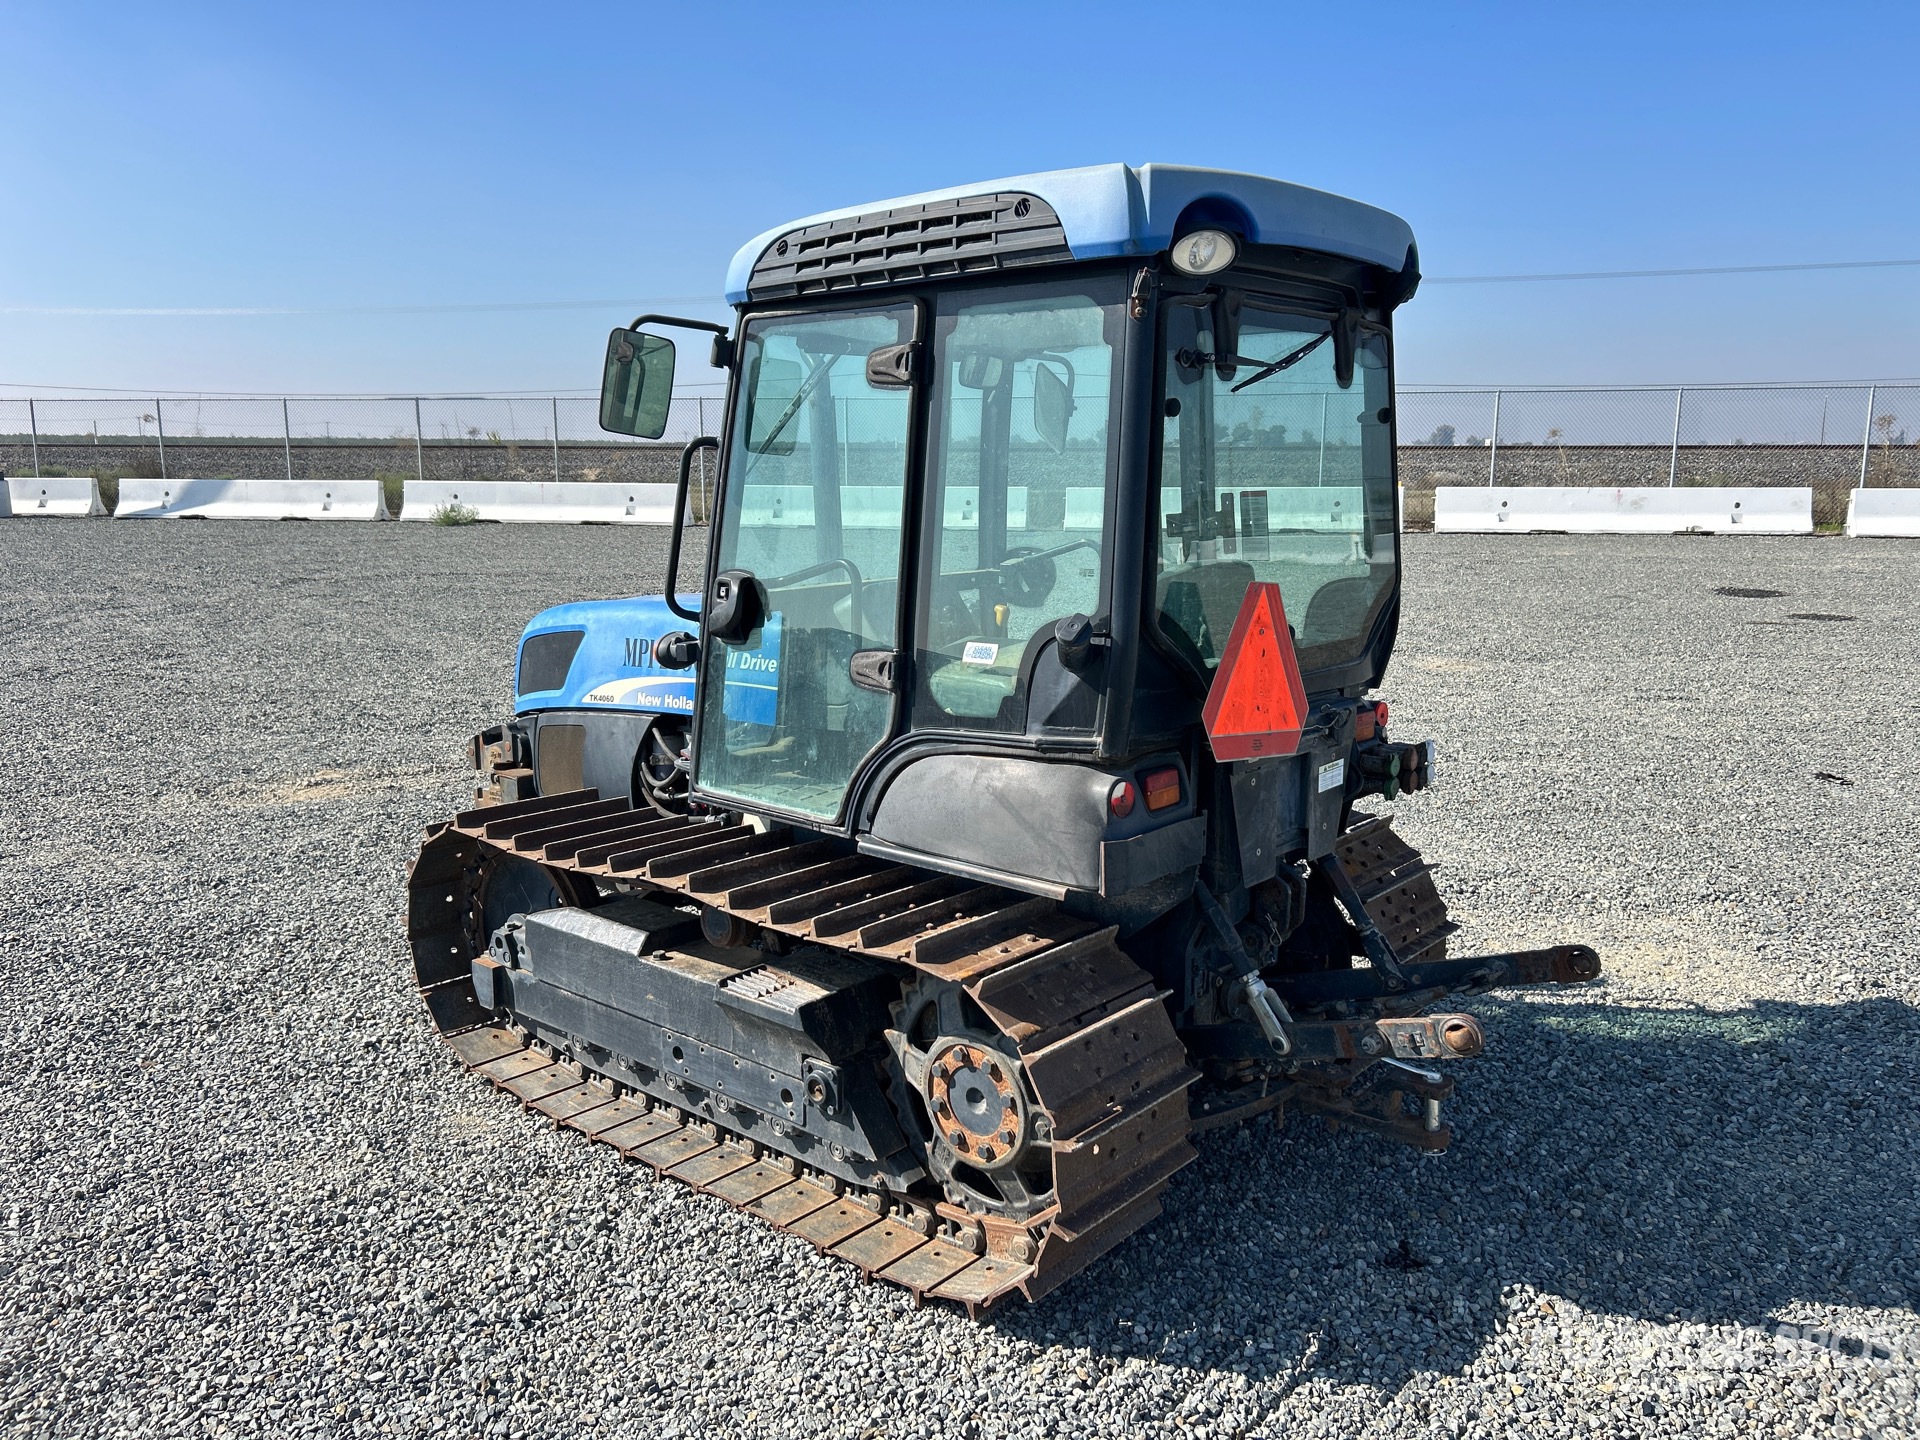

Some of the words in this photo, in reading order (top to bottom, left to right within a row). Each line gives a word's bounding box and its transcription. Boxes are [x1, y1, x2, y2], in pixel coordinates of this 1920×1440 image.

[740, 652, 777, 672] Drive
[589, 694, 614, 703] TK4060
[637, 692, 661, 707] New
[664, 694, 694, 710] Holla
